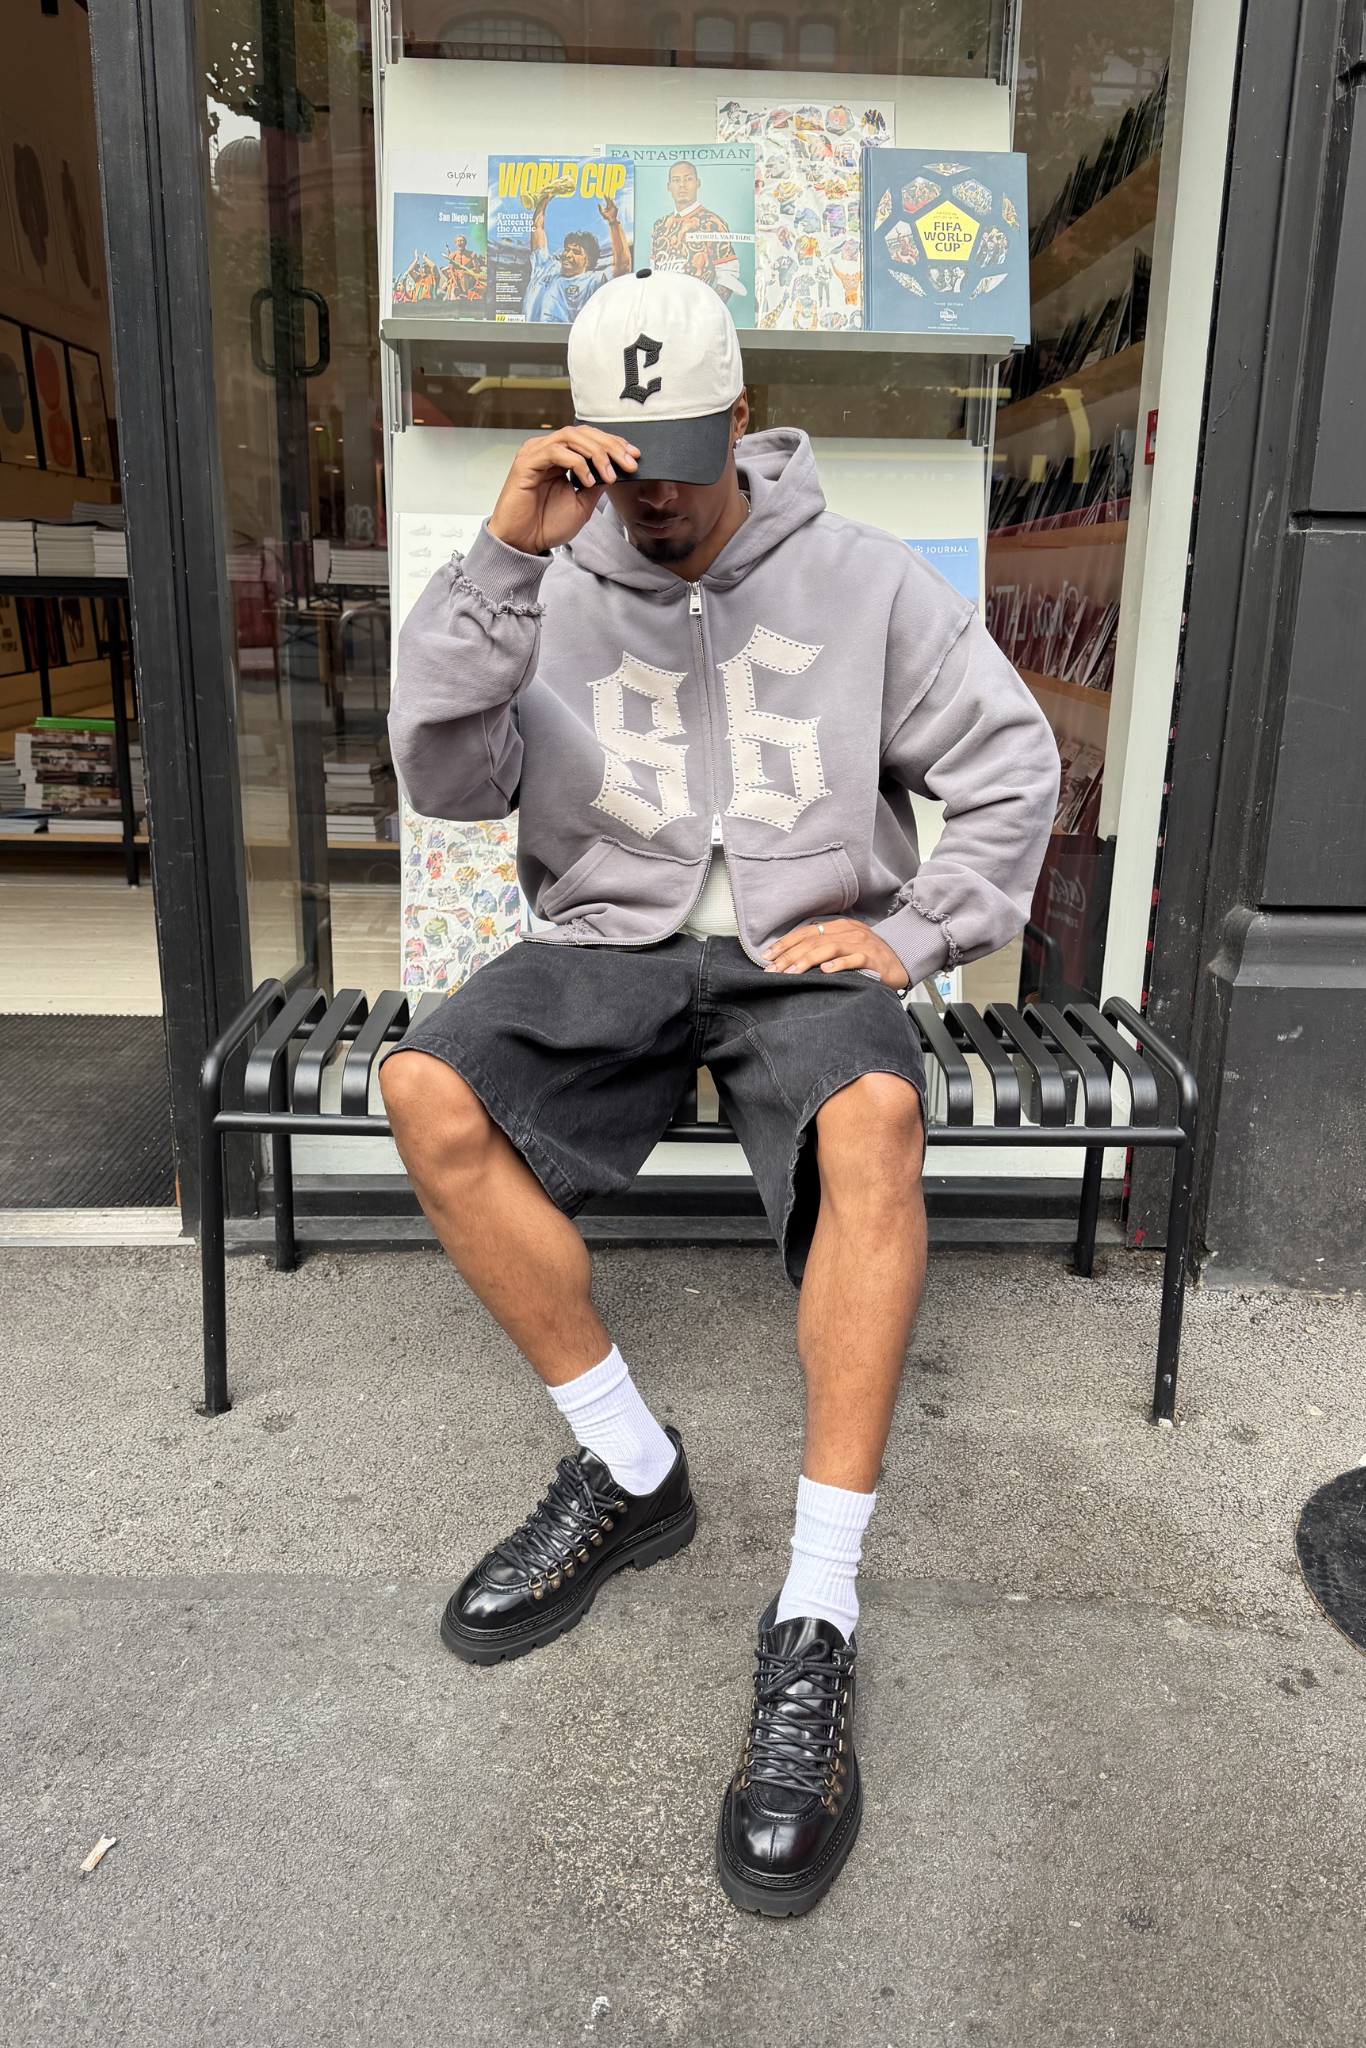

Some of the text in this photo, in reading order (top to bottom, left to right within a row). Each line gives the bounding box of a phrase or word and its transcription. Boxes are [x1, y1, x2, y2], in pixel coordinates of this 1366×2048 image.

[580, 163, 626, 199] CUP
[438, 212, 485, 225] San Diego Loyal
[497, 212, 533, 220] From the
[934, 222, 962, 232] FIFA
[923, 231, 972, 242] WORLD
[935, 242, 961, 252] CUP
[619, 333, 663, 405] C
[926, 544, 969, 554] JOURNAL
